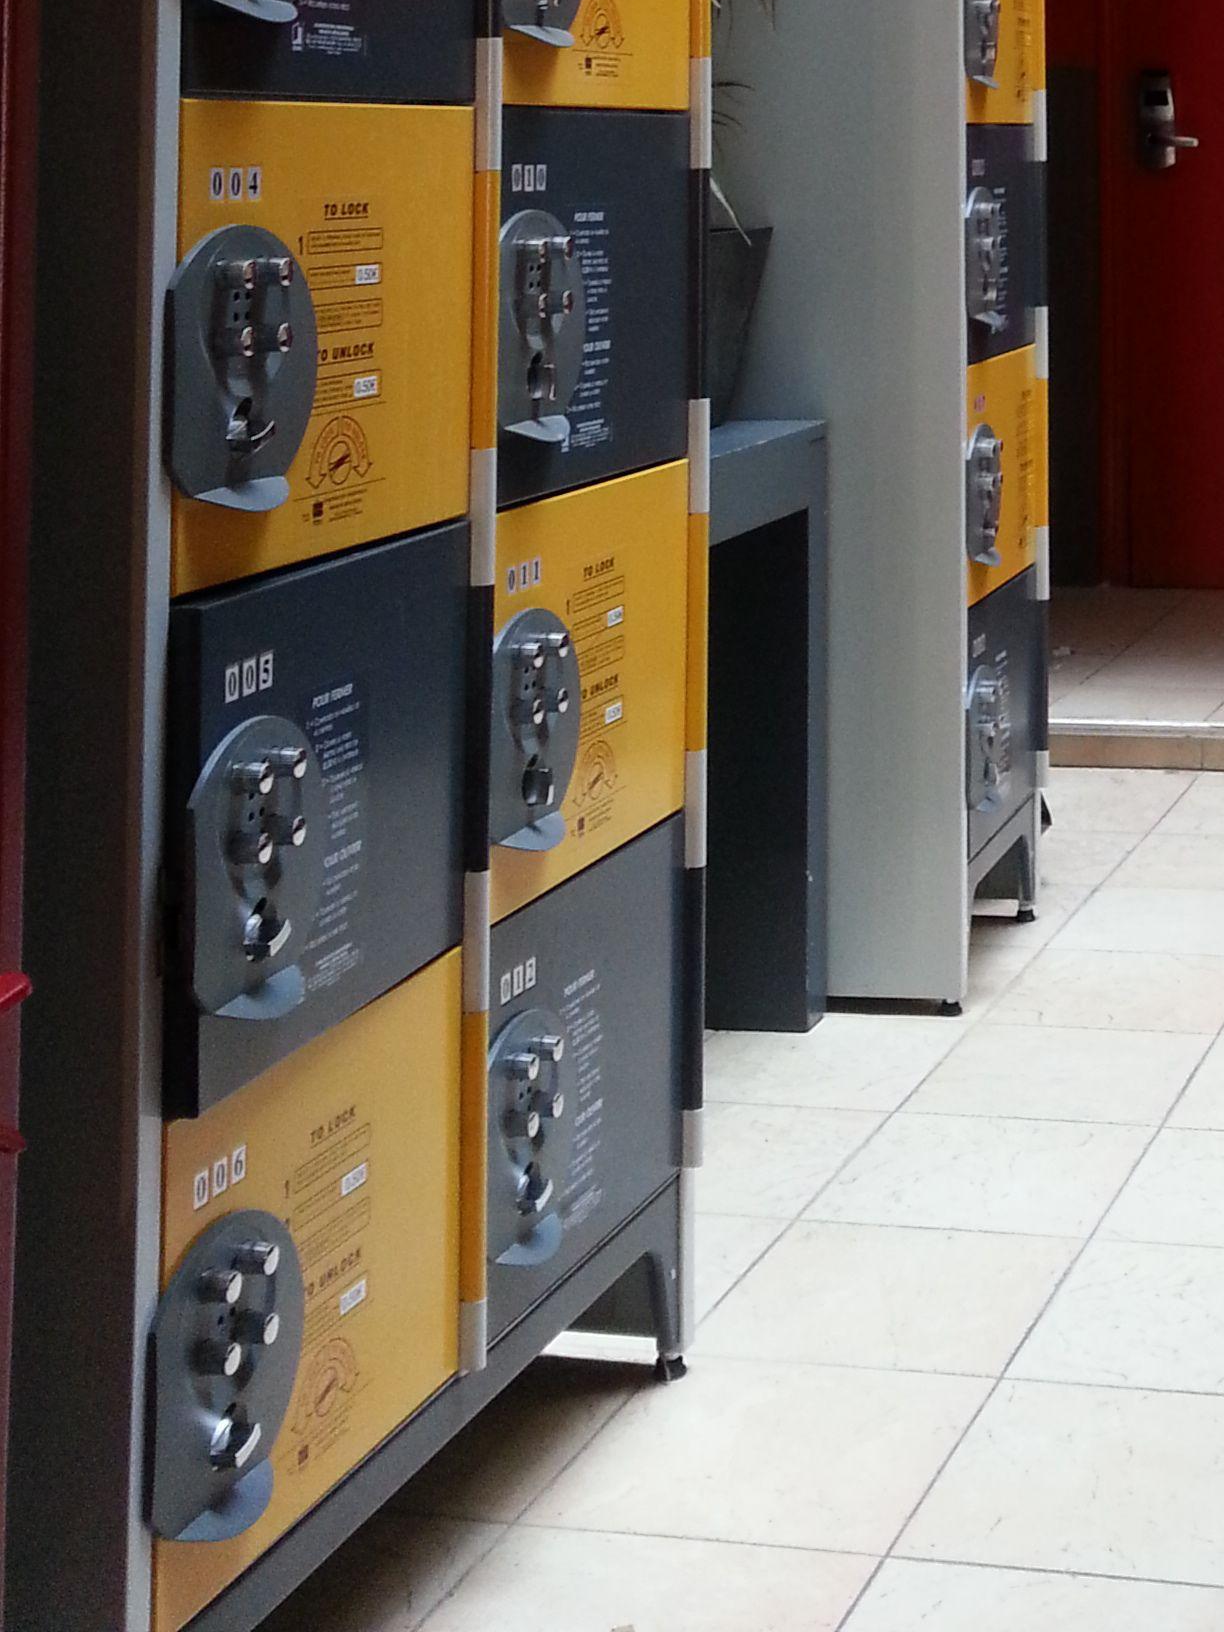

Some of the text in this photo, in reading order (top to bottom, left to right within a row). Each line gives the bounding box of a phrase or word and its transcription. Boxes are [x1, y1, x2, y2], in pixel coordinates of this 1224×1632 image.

[212, 170, 259, 197] 004
[513, 167, 546, 189] 010
[324, 202, 369, 217] TO LOCK
[332, 342, 375, 361] UNLOCK
[508, 560, 540, 591] 011
[583, 557, 615, 578] TO LOCK
[227, 658, 271, 698] 005
[590, 673, 619, 697] UNLOCK
[310, 1105, 356, 1144] TO LOCK
[195, 1147, 244, 1204] 006
